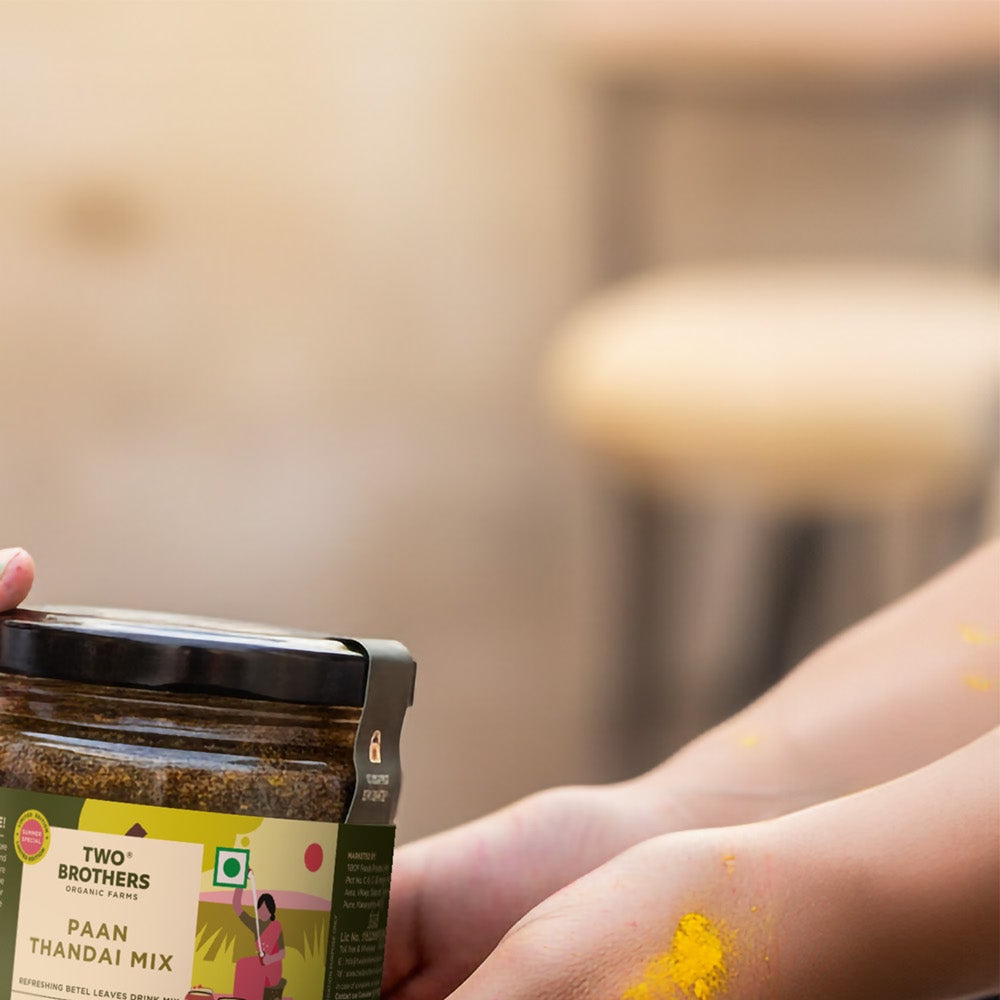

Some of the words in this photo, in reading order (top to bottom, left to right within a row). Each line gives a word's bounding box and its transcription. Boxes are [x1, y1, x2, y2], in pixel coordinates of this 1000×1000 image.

[21, 836, 41, 845] SPECIAL
[22, 829, 42, 837] SUMMER
[58, 864, 150, 890] BROTHERS
[65, 885, 104, 897] ORGANIC
[107, 890, 138, 901] FARMS
[67, 919, 128, 942] PAAN
[29, 936, 121, 966] THANDAI
[130, 950, 174, 972] MIX
[18, 977, 63, 992] REFRESHING
[65, 985, 91, 996] BETEL
[93, 989, 127, 1000] LEAVES
